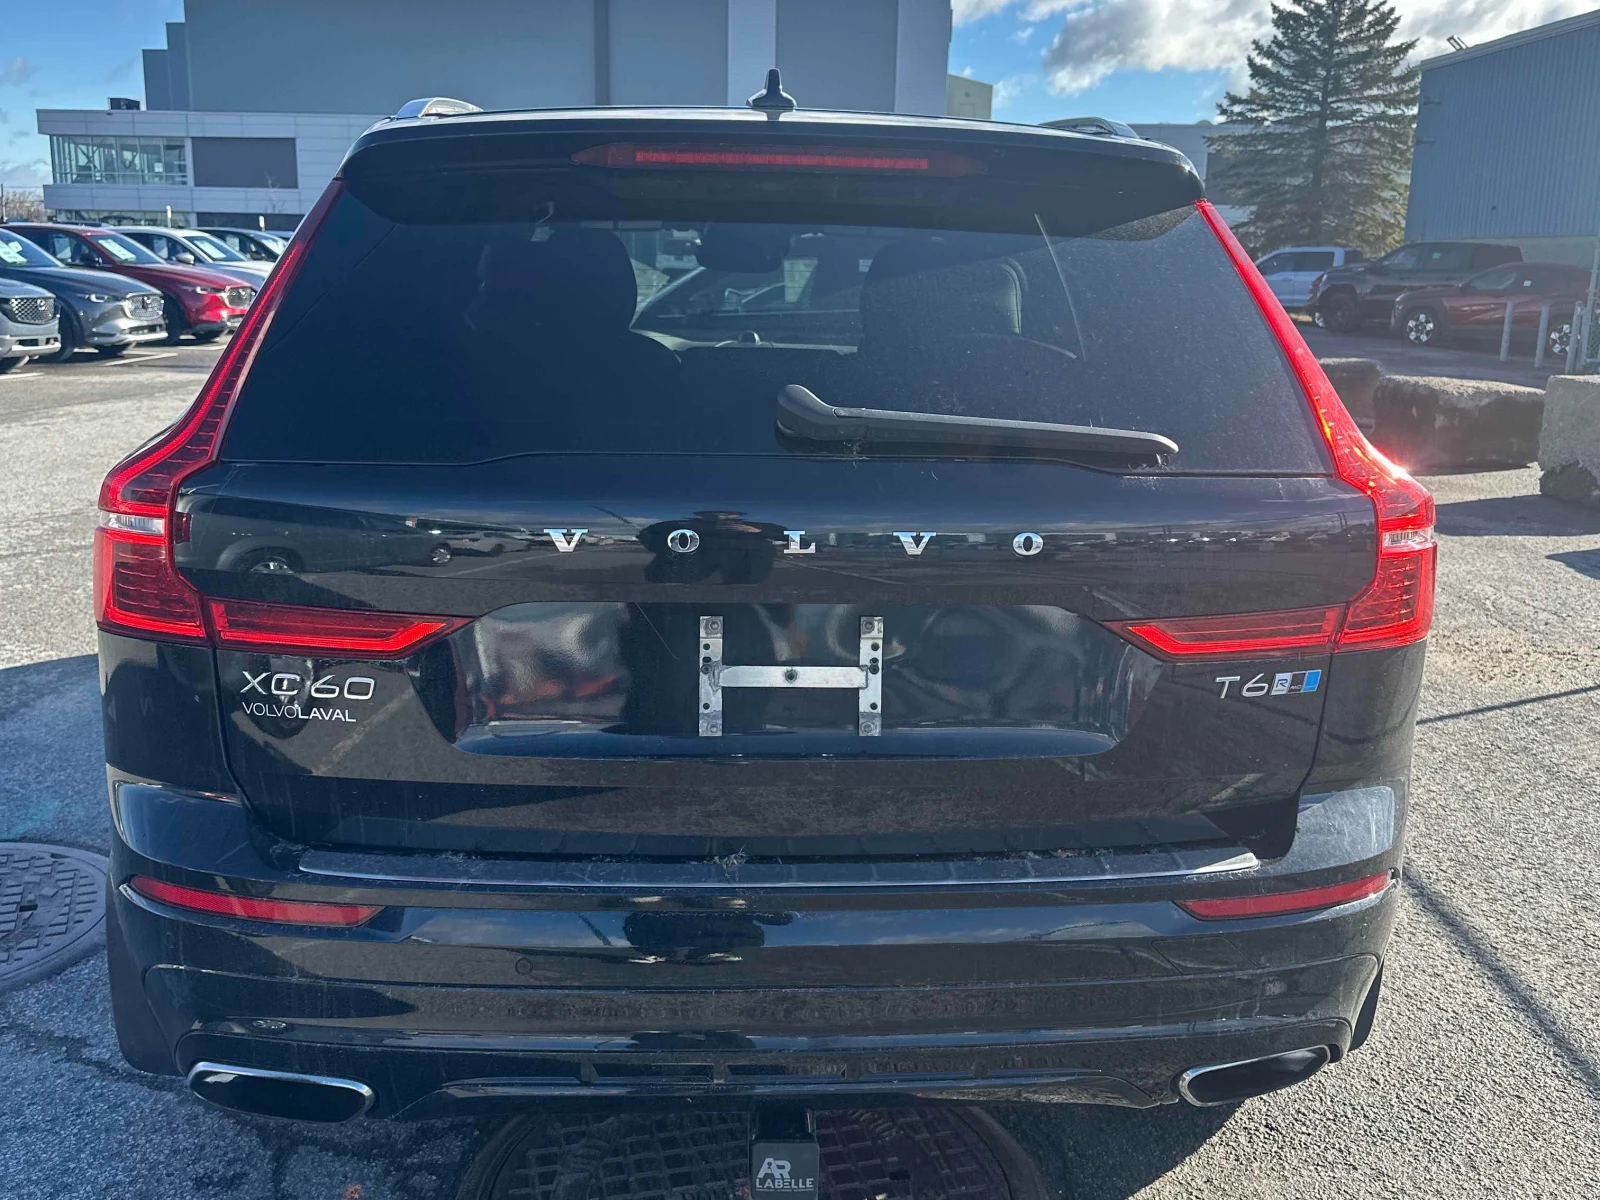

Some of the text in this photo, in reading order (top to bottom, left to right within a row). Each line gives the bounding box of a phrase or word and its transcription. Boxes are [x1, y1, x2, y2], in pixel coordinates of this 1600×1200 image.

[543, 528, 1044, 556] VOLVO
[1215, 673, 1268, 699] T6
[757, 1157, 791, 1178] AR
[756, 1178, 814, 1189] LABELLE
